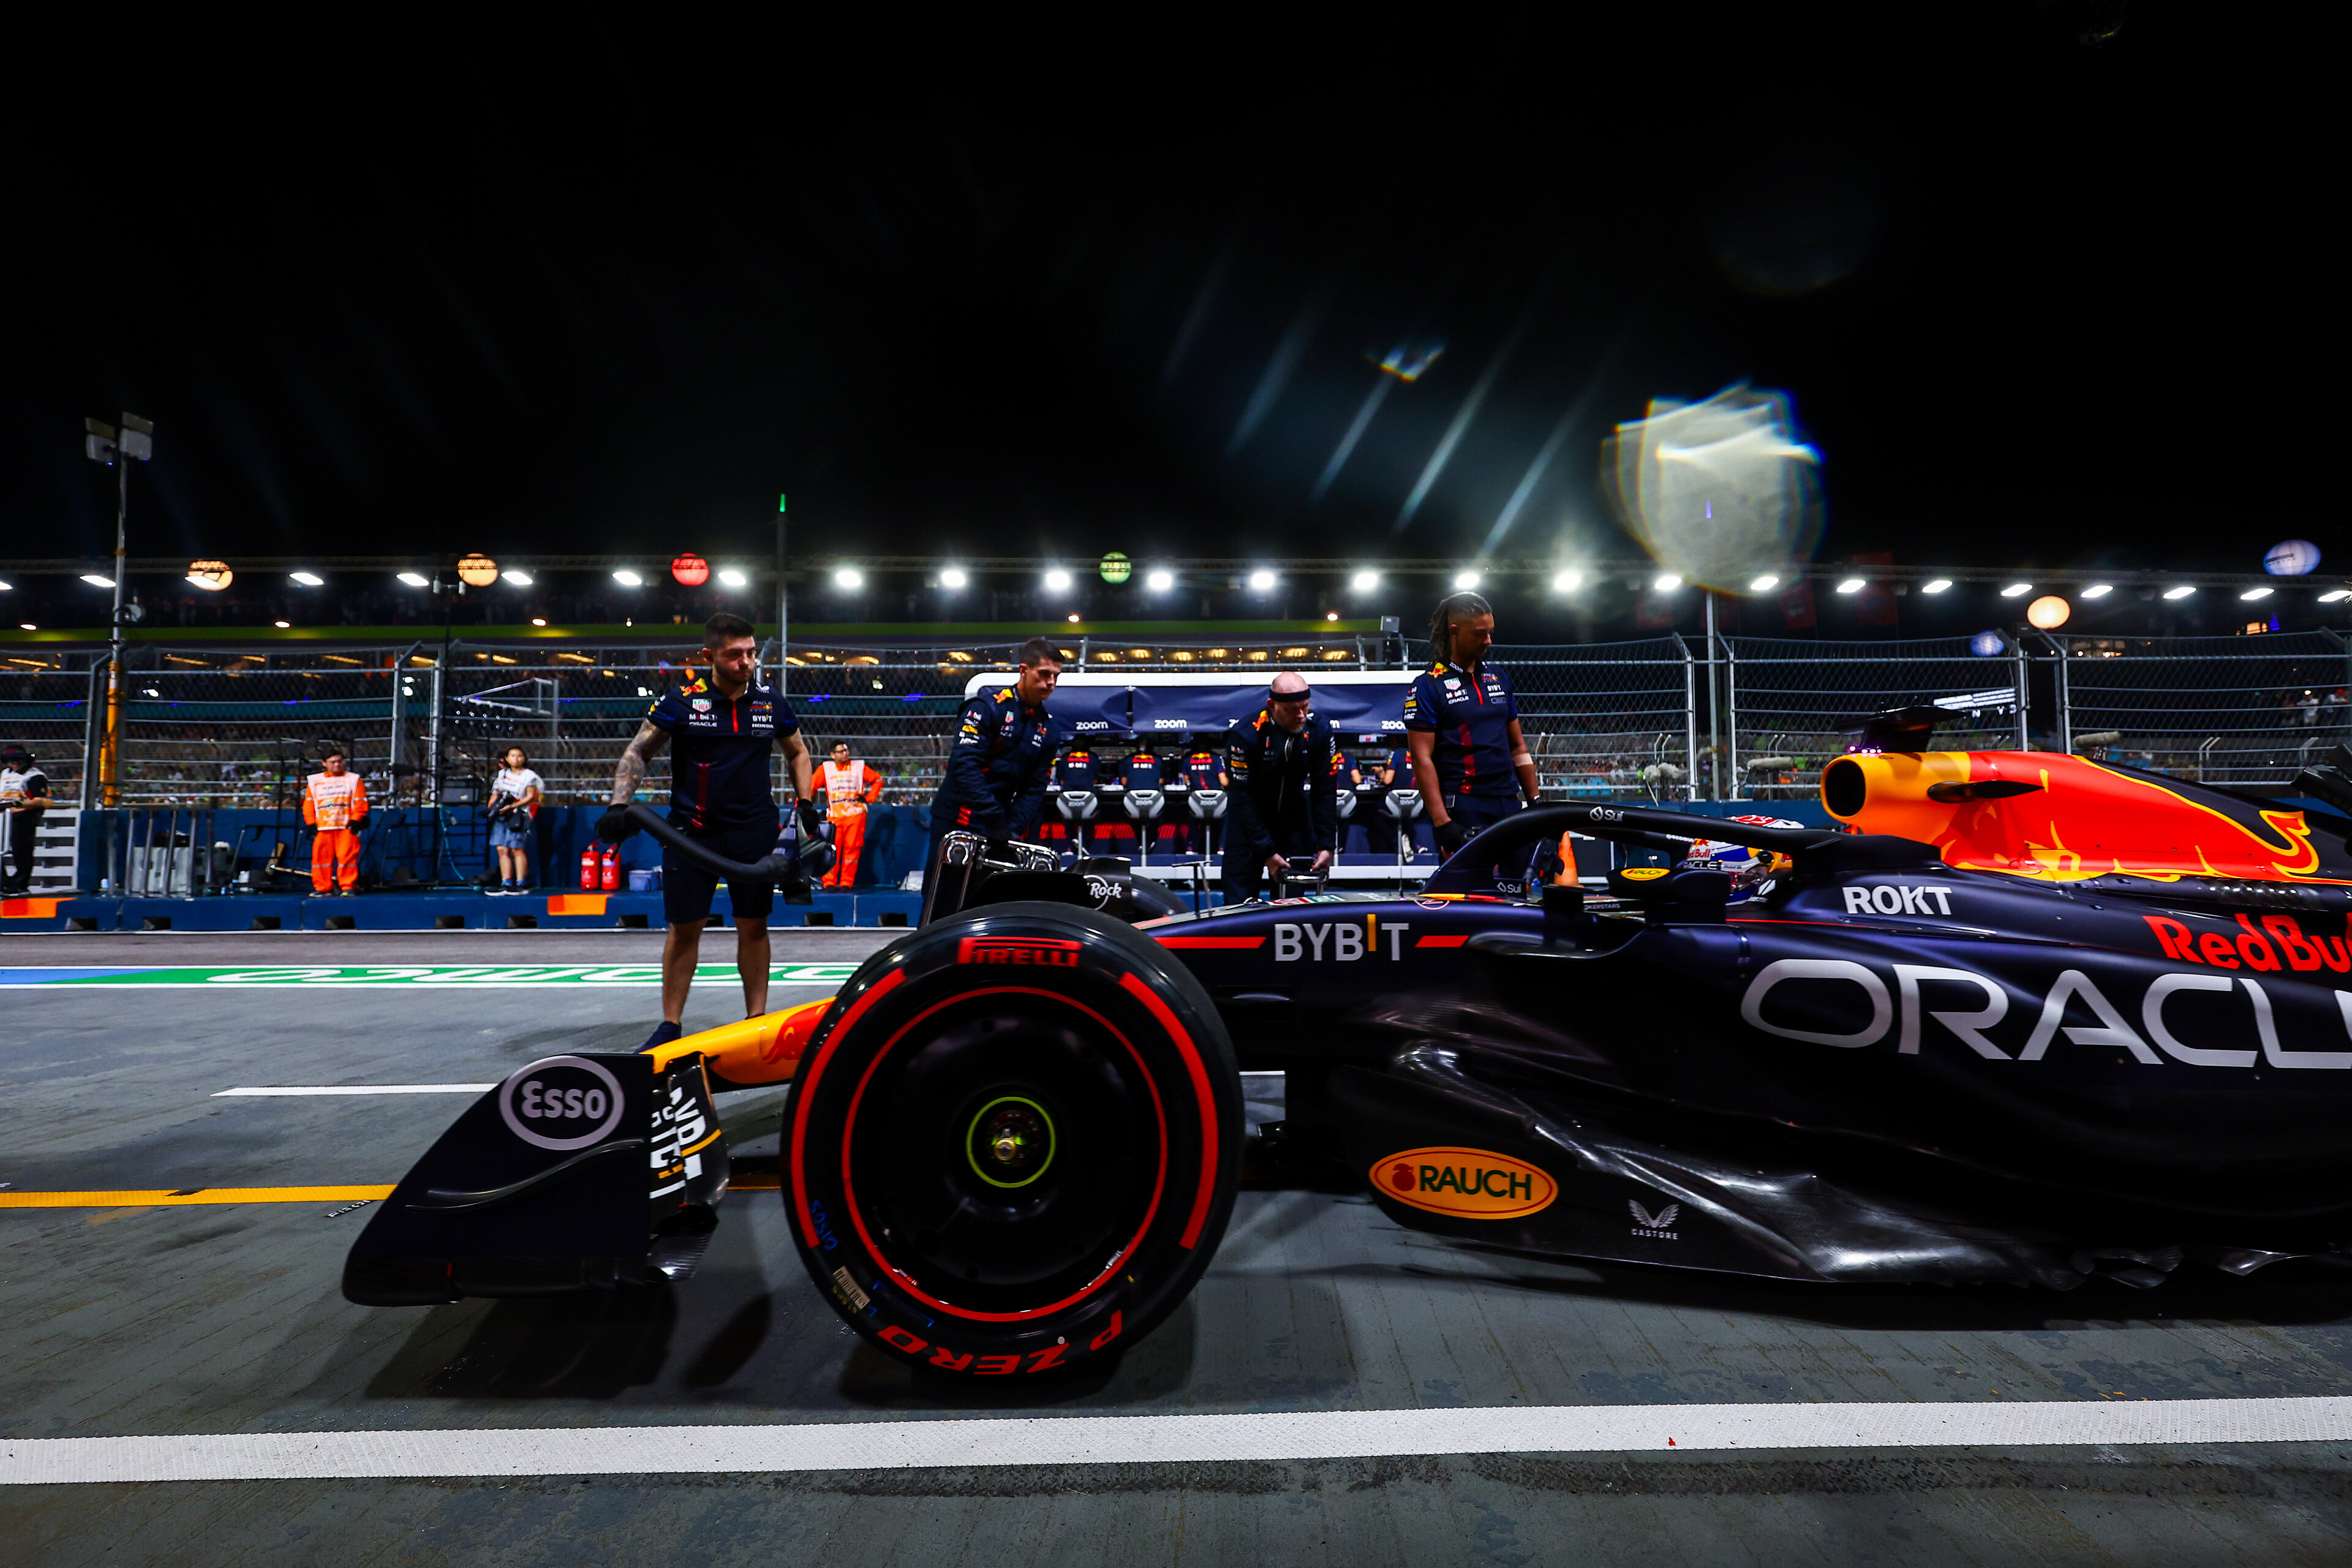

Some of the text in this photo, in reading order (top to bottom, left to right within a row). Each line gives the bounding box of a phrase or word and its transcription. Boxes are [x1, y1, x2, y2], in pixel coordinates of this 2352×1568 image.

[752, 714, 772, 723] BYBIT
[1154, 719, 1187, 729] zoom
[1381, 720, 1406, 729] zoo
[1076, 721, 1109, 730] zoom
[1604, 809, 1624, 822] Sui
[1695, 849, 1711, 859] Bull
[1684, 861, 1718, 870] RACLE
[1090, 882, 1122, 899] Rock
[1507, 884, 1521, 894] Sui
[1842, 886, 1953, 915] ROKT
[1274, 913, 1409, 962] BYBIT
[2142, 913, 2282, 971] Red
[956, 936, 1082, 968] PIRELLI
[1741, 959, 2352, 1069] ORACL
[1420, 1165, 1531, 1200] RAUCH
[1631, 1228, 1678, 1240] CASTORE
[876, 1309, 1122, 1375] P ZERO
